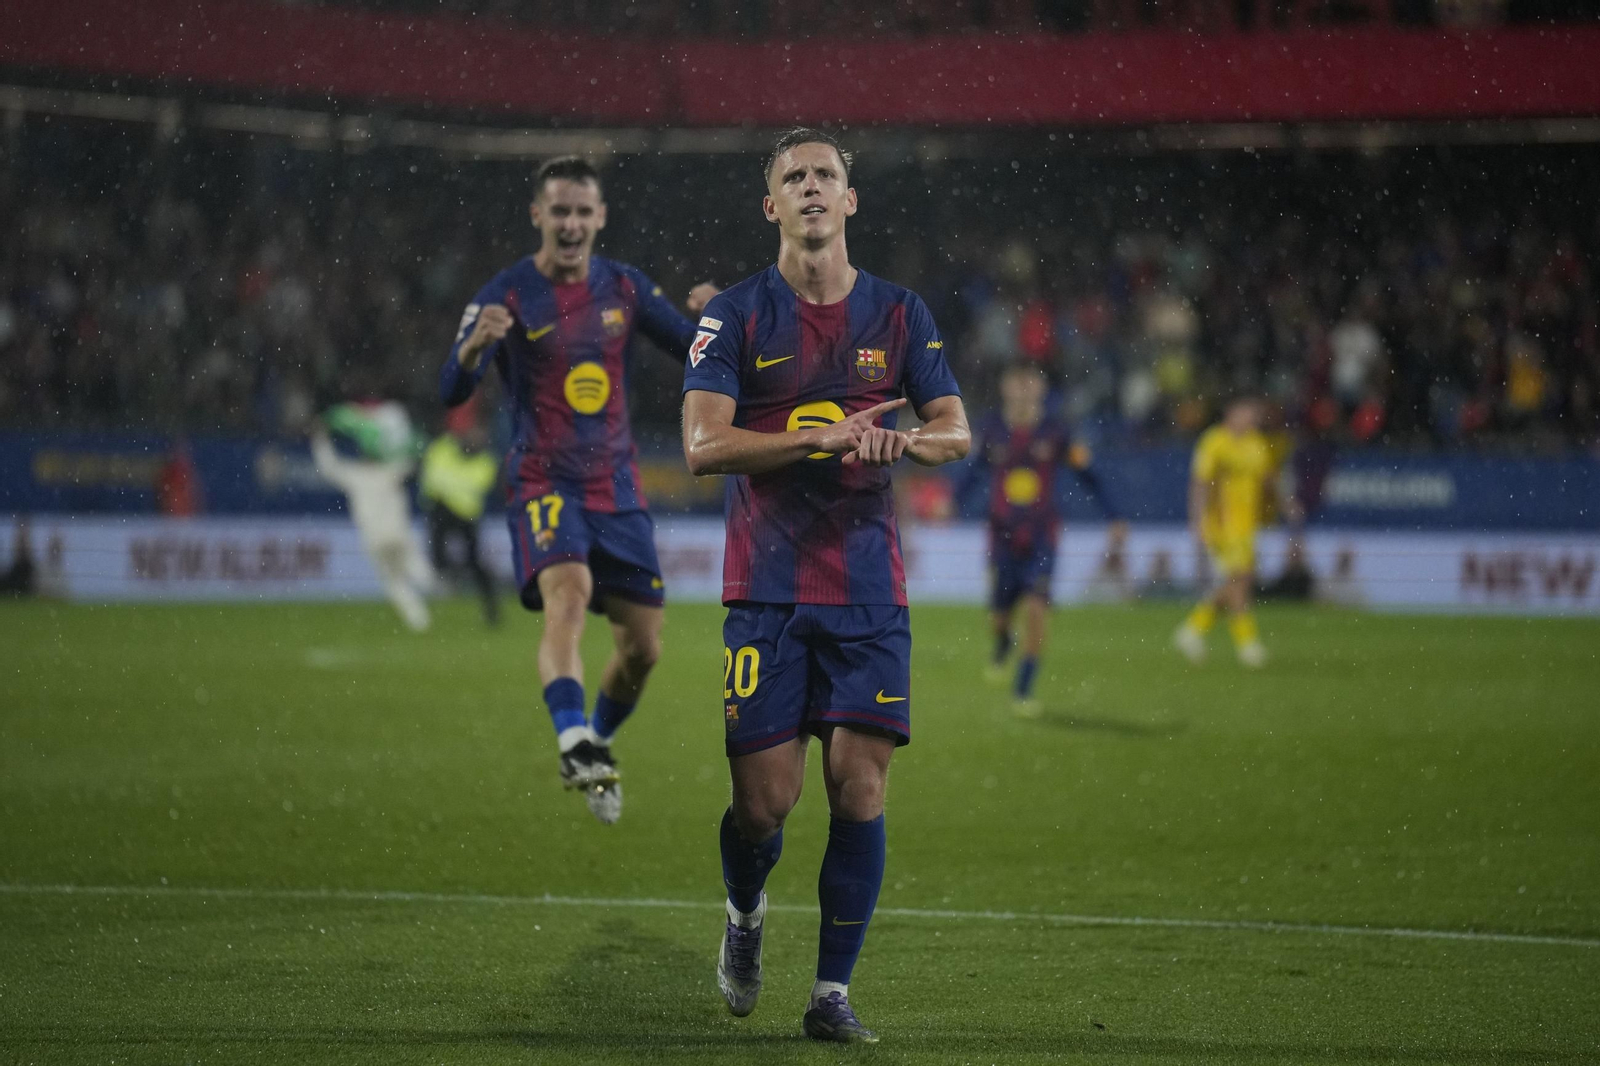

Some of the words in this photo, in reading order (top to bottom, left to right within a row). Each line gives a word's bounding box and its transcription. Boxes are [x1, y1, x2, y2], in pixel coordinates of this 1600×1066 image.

[526, 495, 564, 533] 17
[1461, 551, 1596, 598] NEW
[724, 646, 760, 699] 20
